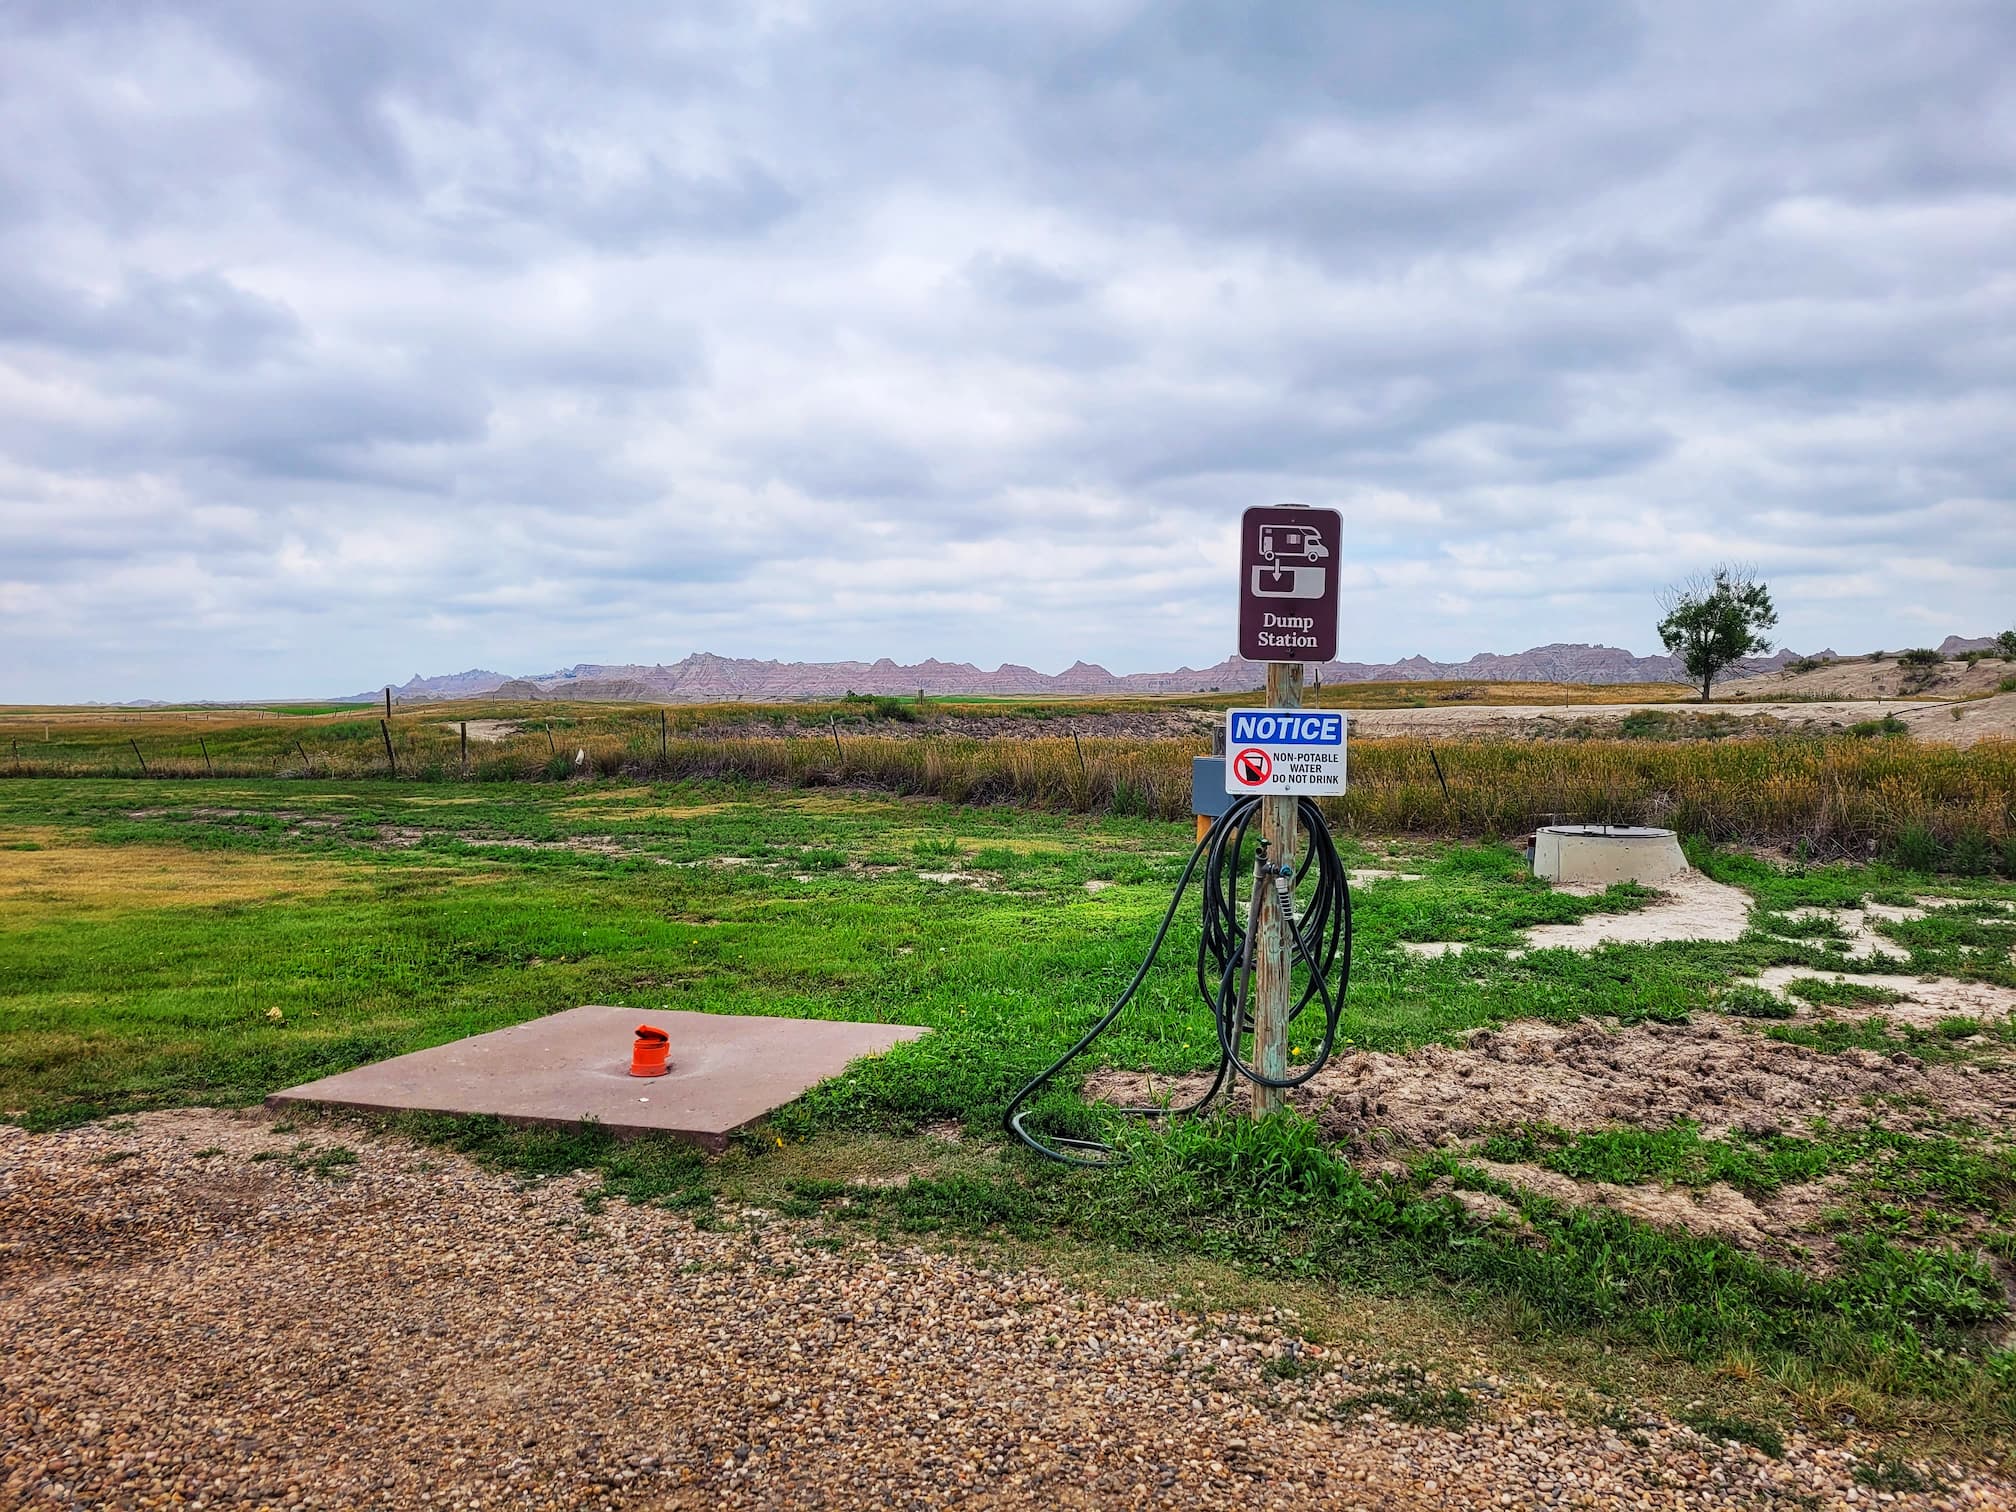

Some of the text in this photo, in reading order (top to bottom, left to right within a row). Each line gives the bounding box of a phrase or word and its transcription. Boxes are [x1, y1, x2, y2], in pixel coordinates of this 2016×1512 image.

[1263, 612, 1314, 632] Dump
[1258, 631, 1318, 648] Station
[1235, 716, 1339, 740] NOTICE
[1273, 752, 1339, 763] NON-POTABLE
[1290, 763, 1322, 773] WATER
[1272, 774, 1339, 785] DO NOT DRINK
